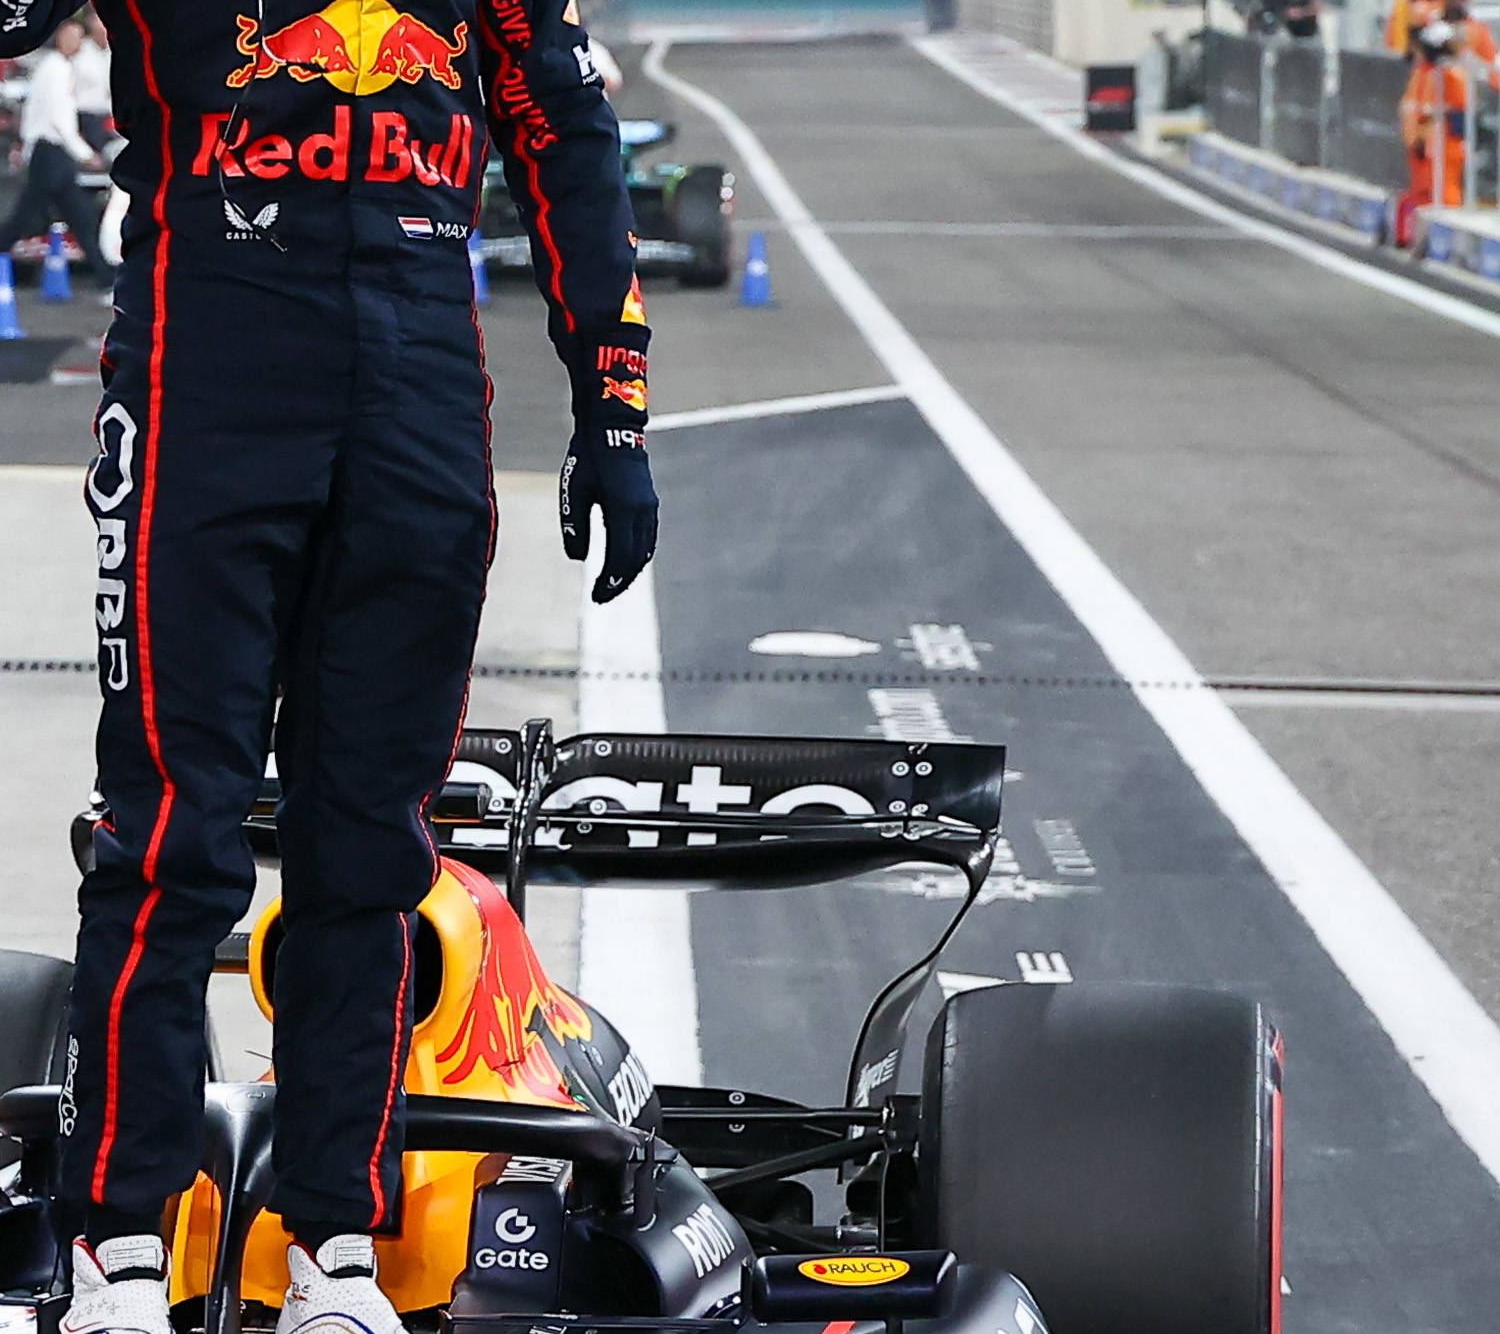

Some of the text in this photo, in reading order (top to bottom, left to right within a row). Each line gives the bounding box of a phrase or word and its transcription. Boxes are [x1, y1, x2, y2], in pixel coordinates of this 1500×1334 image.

[191, 104, 351, 182] Red
[364, 111, 474, 188] Bull
[436, 222, 469, 240] MAX
[562, 455, 578, 516] sparco
[496, 1155, 571, 1185] VISA
[475, 1248, 550, 1270] Gate
[829, 1260, 896, 1277] RAUCH
